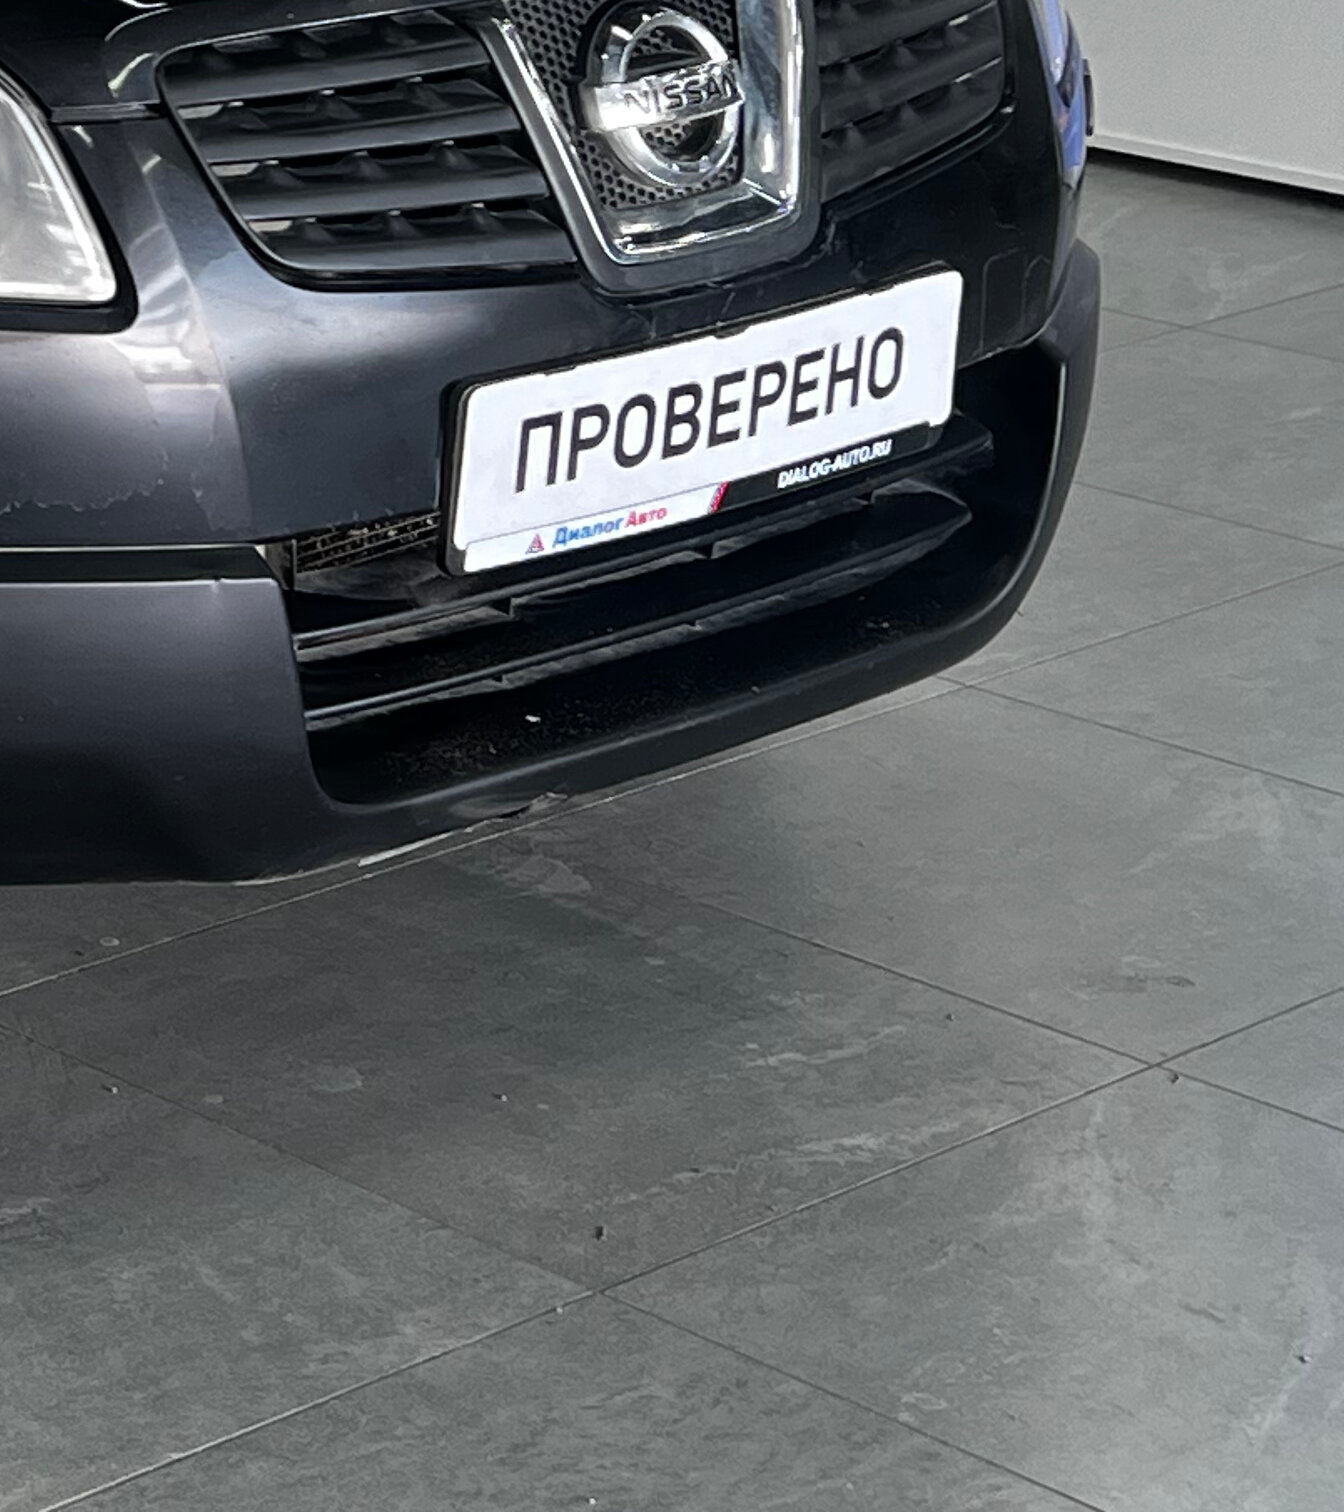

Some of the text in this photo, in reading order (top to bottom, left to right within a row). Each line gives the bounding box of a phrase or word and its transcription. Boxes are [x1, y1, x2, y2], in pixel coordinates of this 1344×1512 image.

[623, 72, 739, 115] NISSAN
[514, 327, 905, 494] ПРОВЕРЕНО
[777, 439, 893, 489] DIALOG-AUTO.RU
